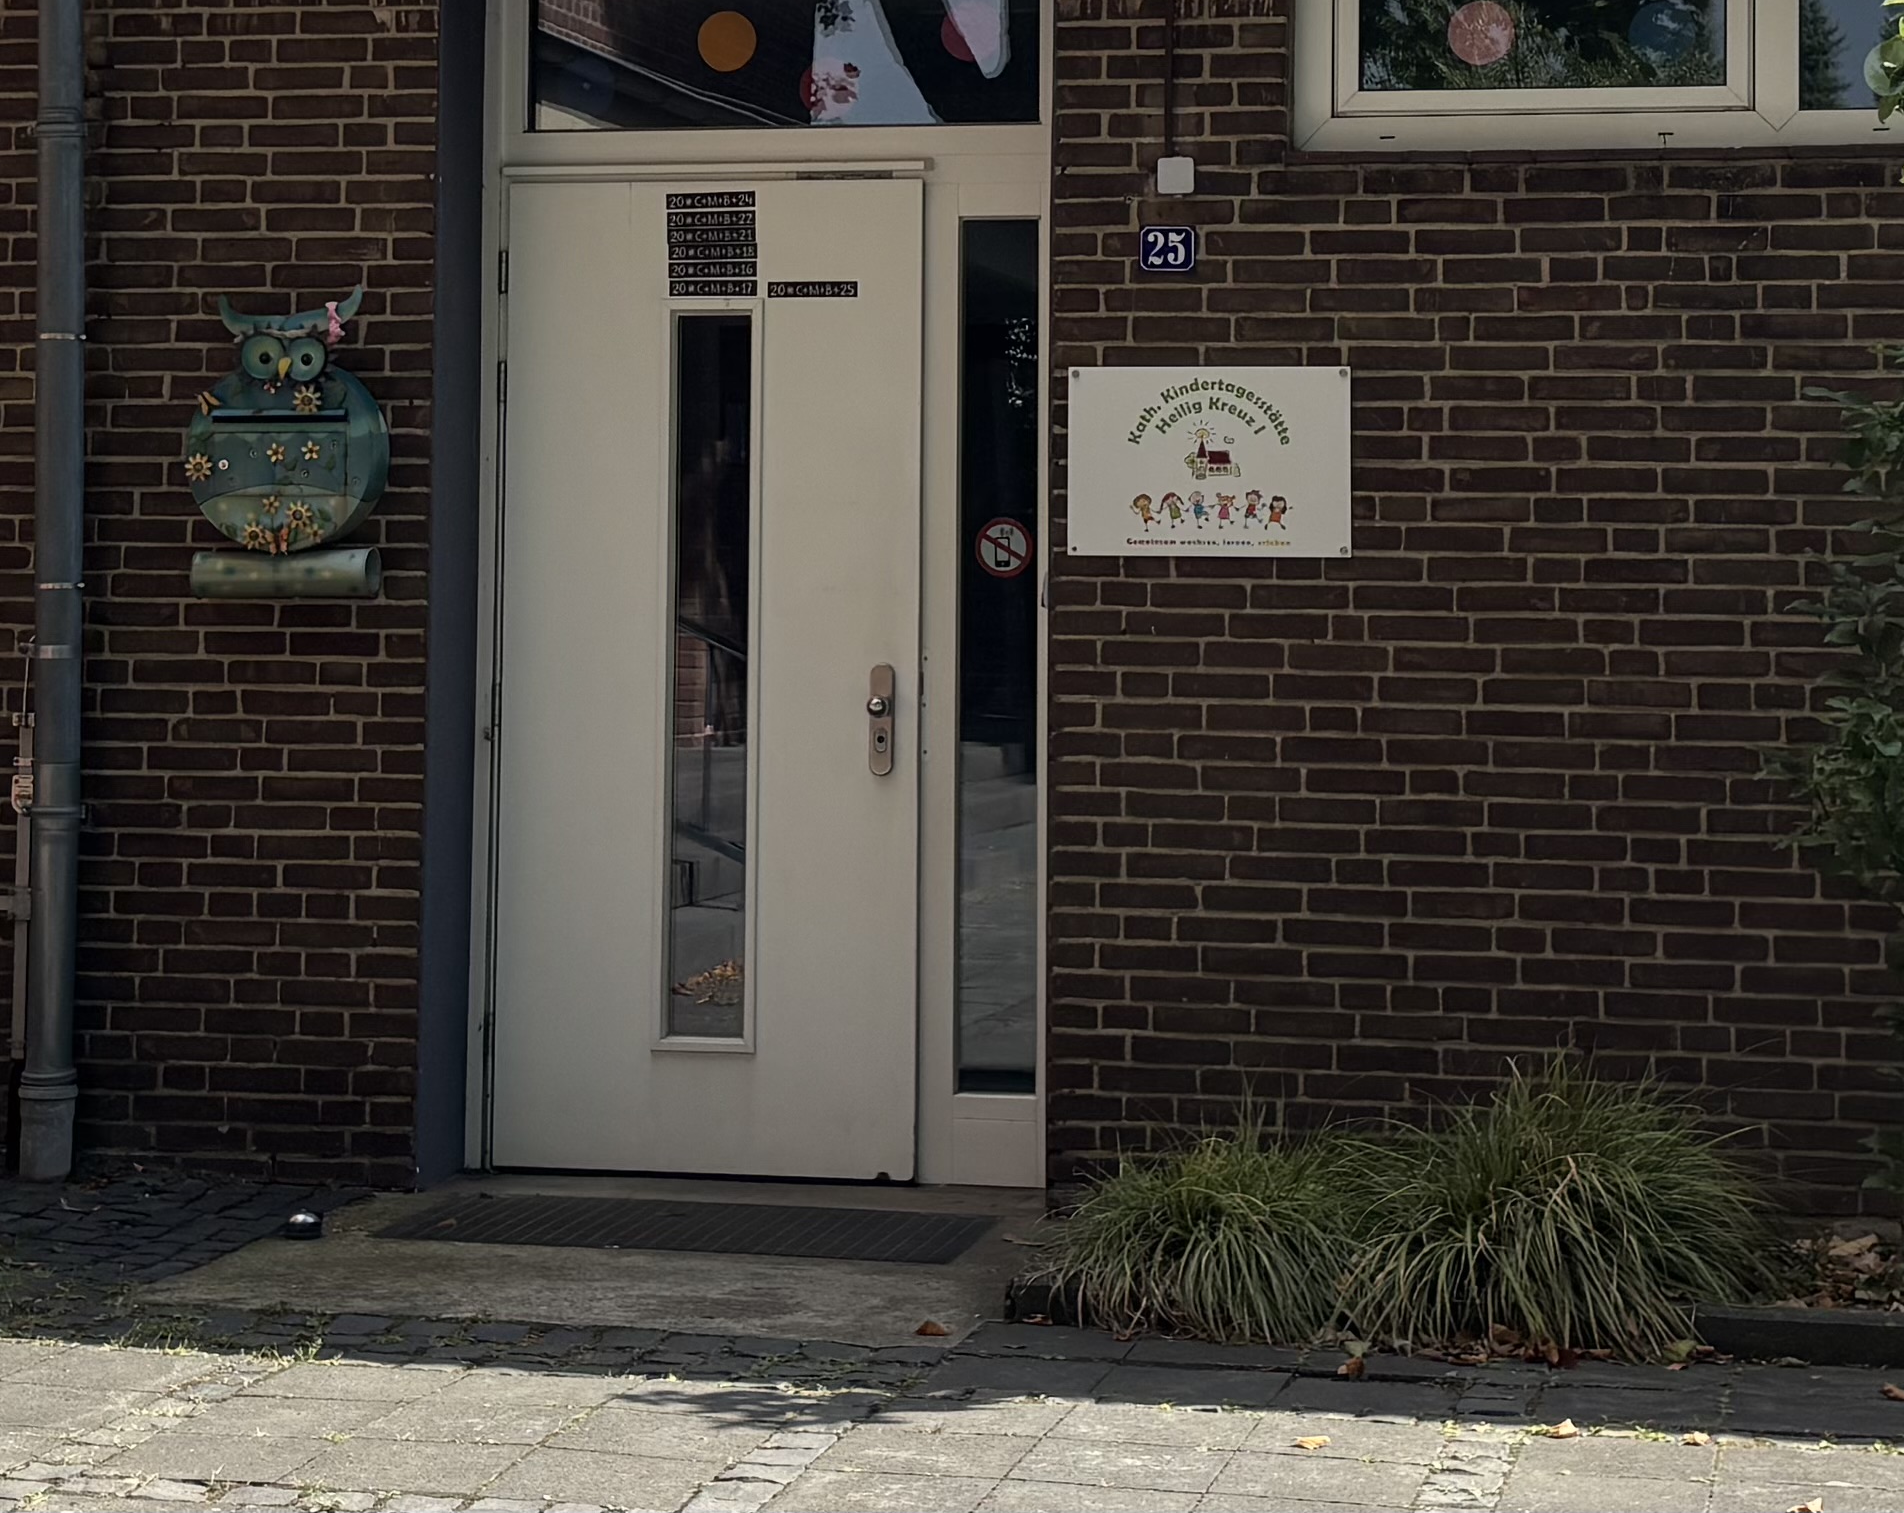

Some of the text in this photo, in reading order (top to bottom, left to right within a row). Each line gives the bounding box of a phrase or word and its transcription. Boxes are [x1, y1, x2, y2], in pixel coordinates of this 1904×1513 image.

[1147, 231, 1186, 265] 25
[1127, 377, 1291, 446] Kath. Kindertagesstätte
[1155, 401, 1203, 434] Heilig
[1208, 396, 1257, 428] Kreuz
